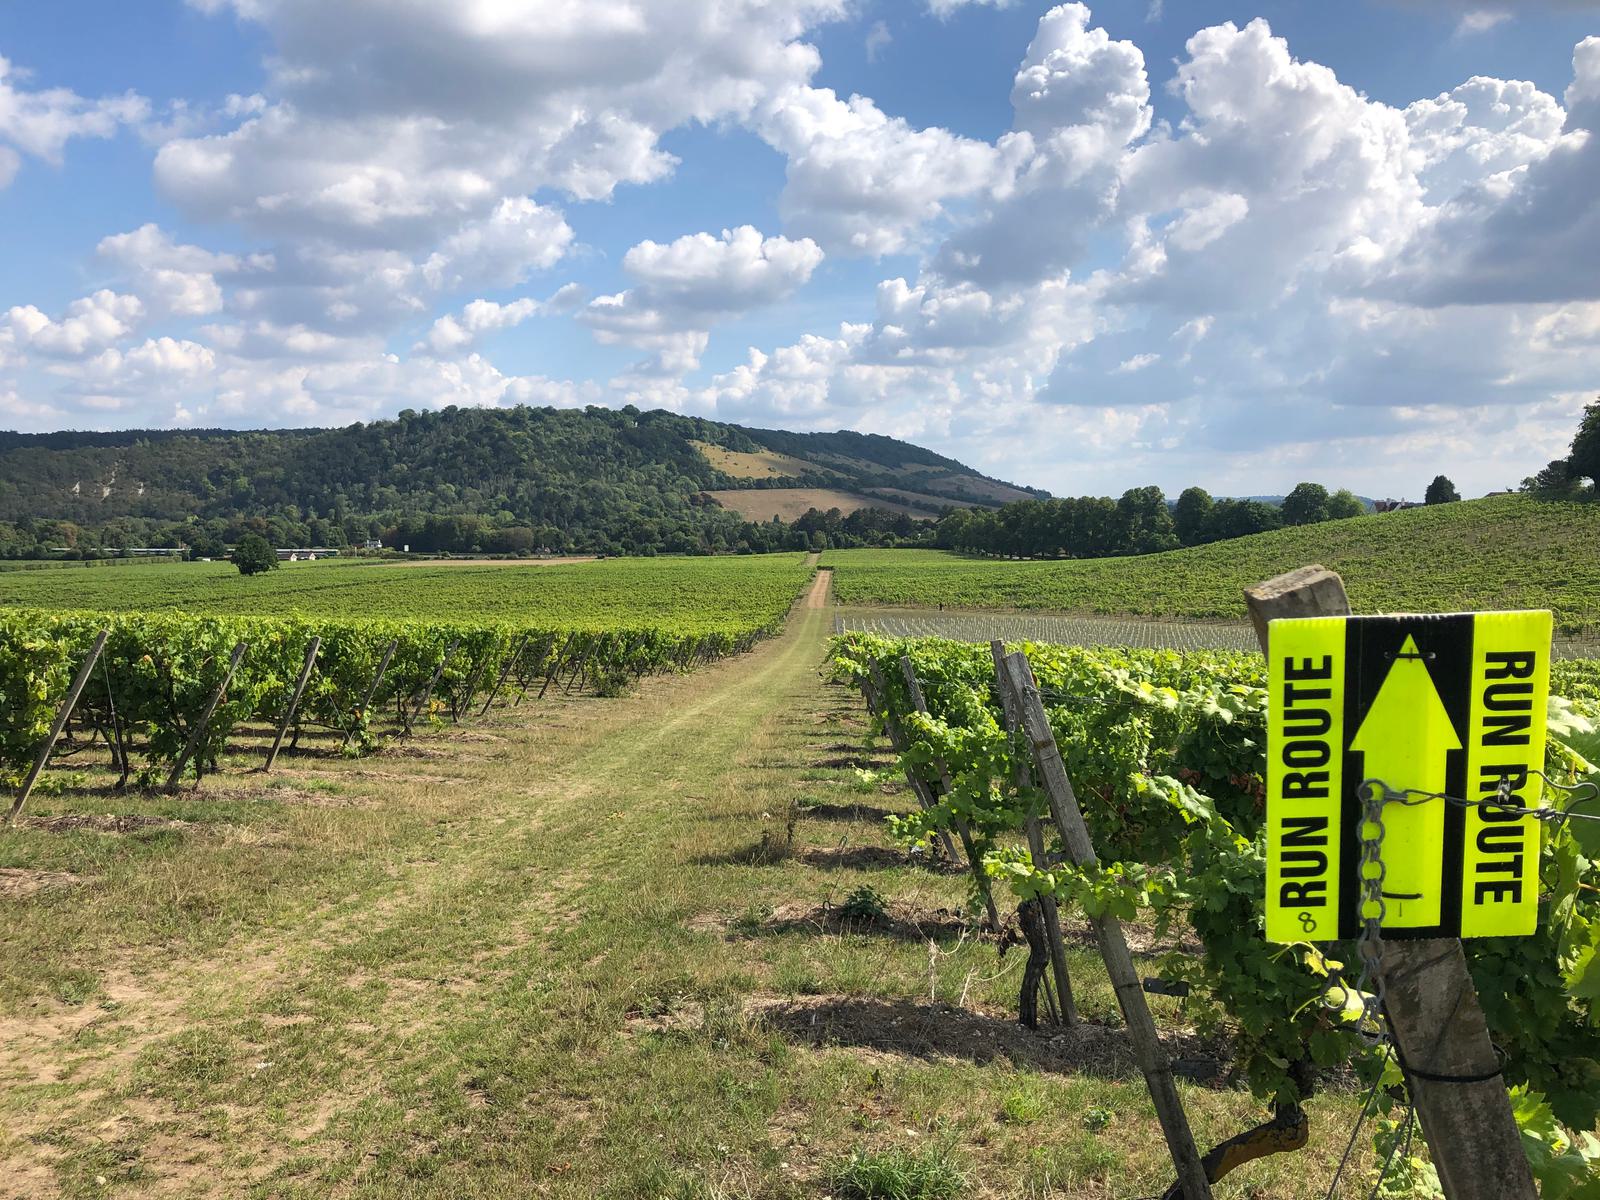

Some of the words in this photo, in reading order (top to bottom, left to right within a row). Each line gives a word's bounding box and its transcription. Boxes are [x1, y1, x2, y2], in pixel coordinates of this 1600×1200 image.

[1281, 655, 1332, 799] ROUTE
[1480, 651, 1536, 746] RUN
[1280, 816, 1328, 908] RUN
[1474, 763, 1528, 905] ROUTE
[1298, 911, 1317, 934] 8
